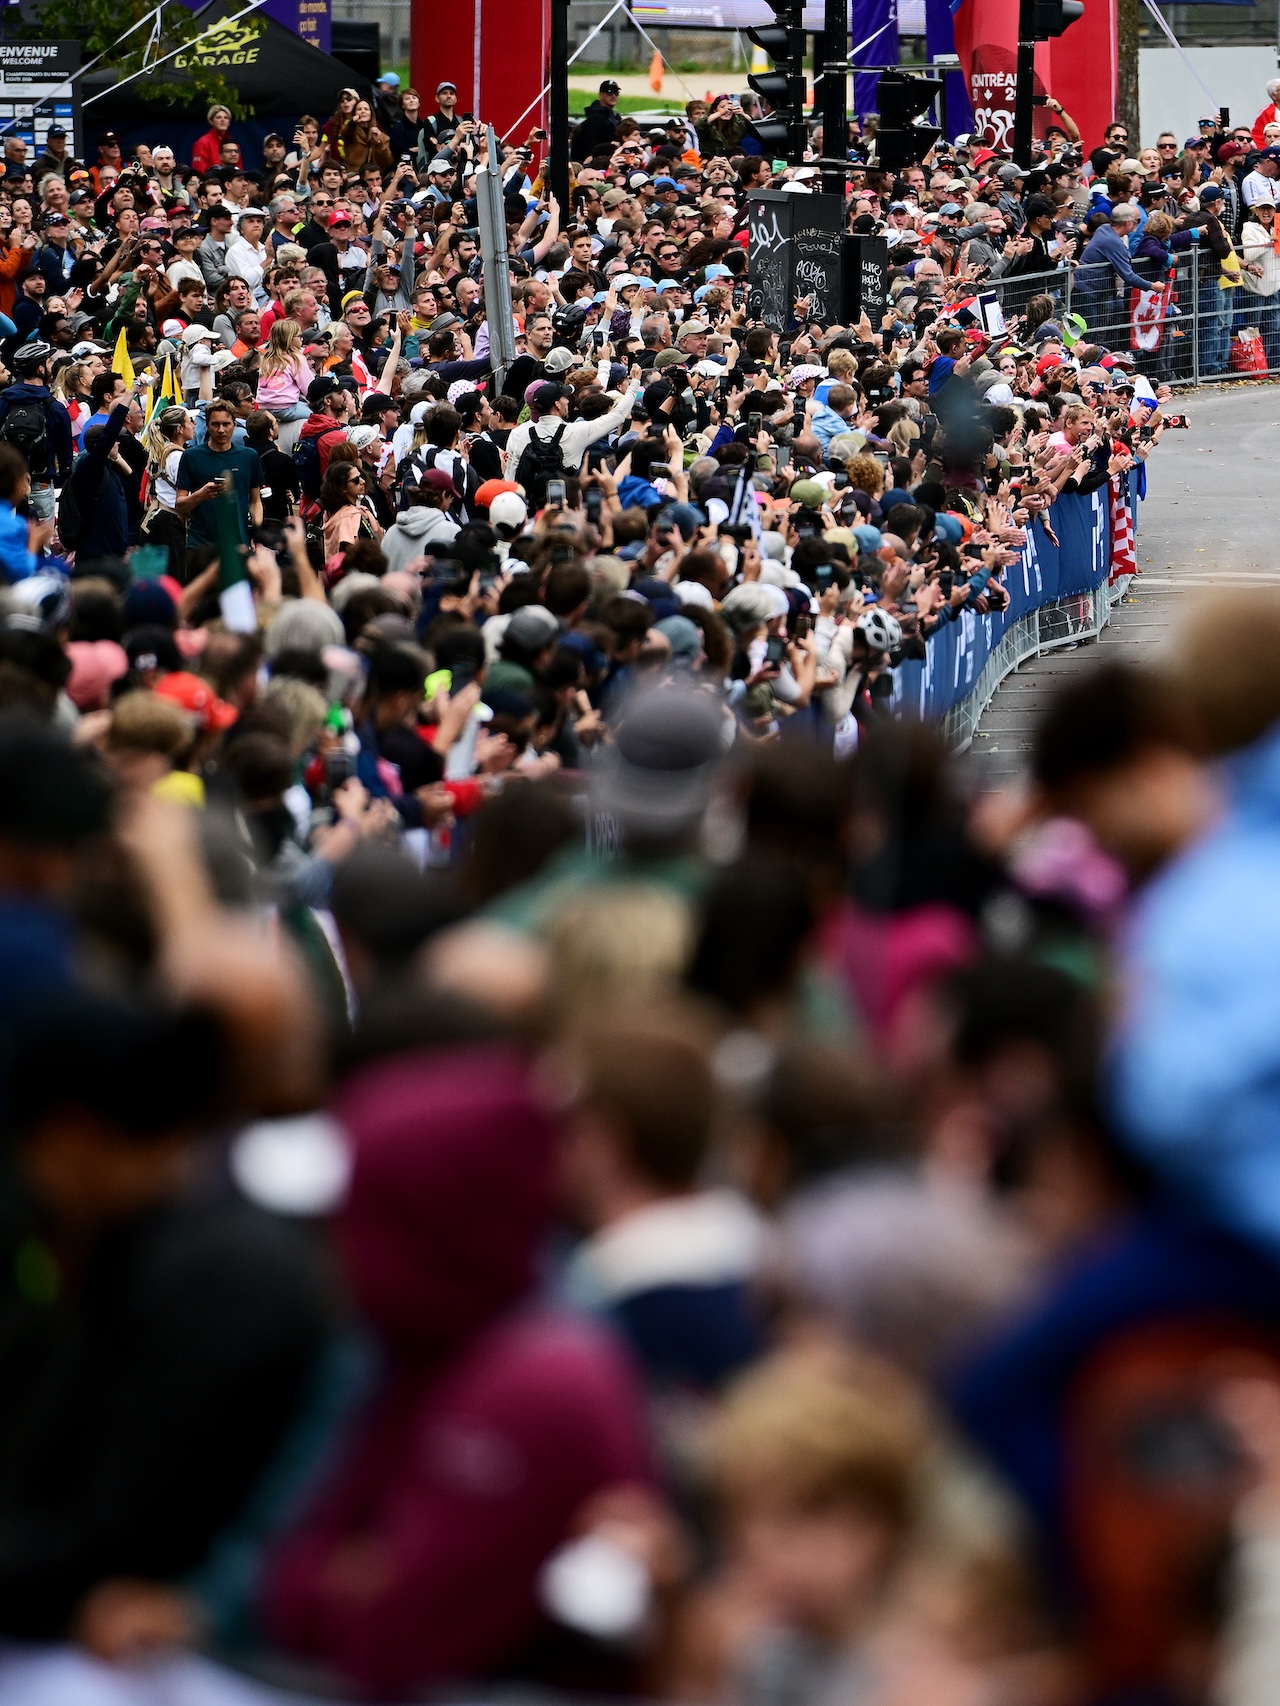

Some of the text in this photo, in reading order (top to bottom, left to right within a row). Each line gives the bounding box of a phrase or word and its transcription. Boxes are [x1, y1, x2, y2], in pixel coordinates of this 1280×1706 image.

[2, 57, 43, 65] WELCOME
[174, 48, 261, 69] GARAGE
[971, 71, 1017, 87] ONTRÉA
